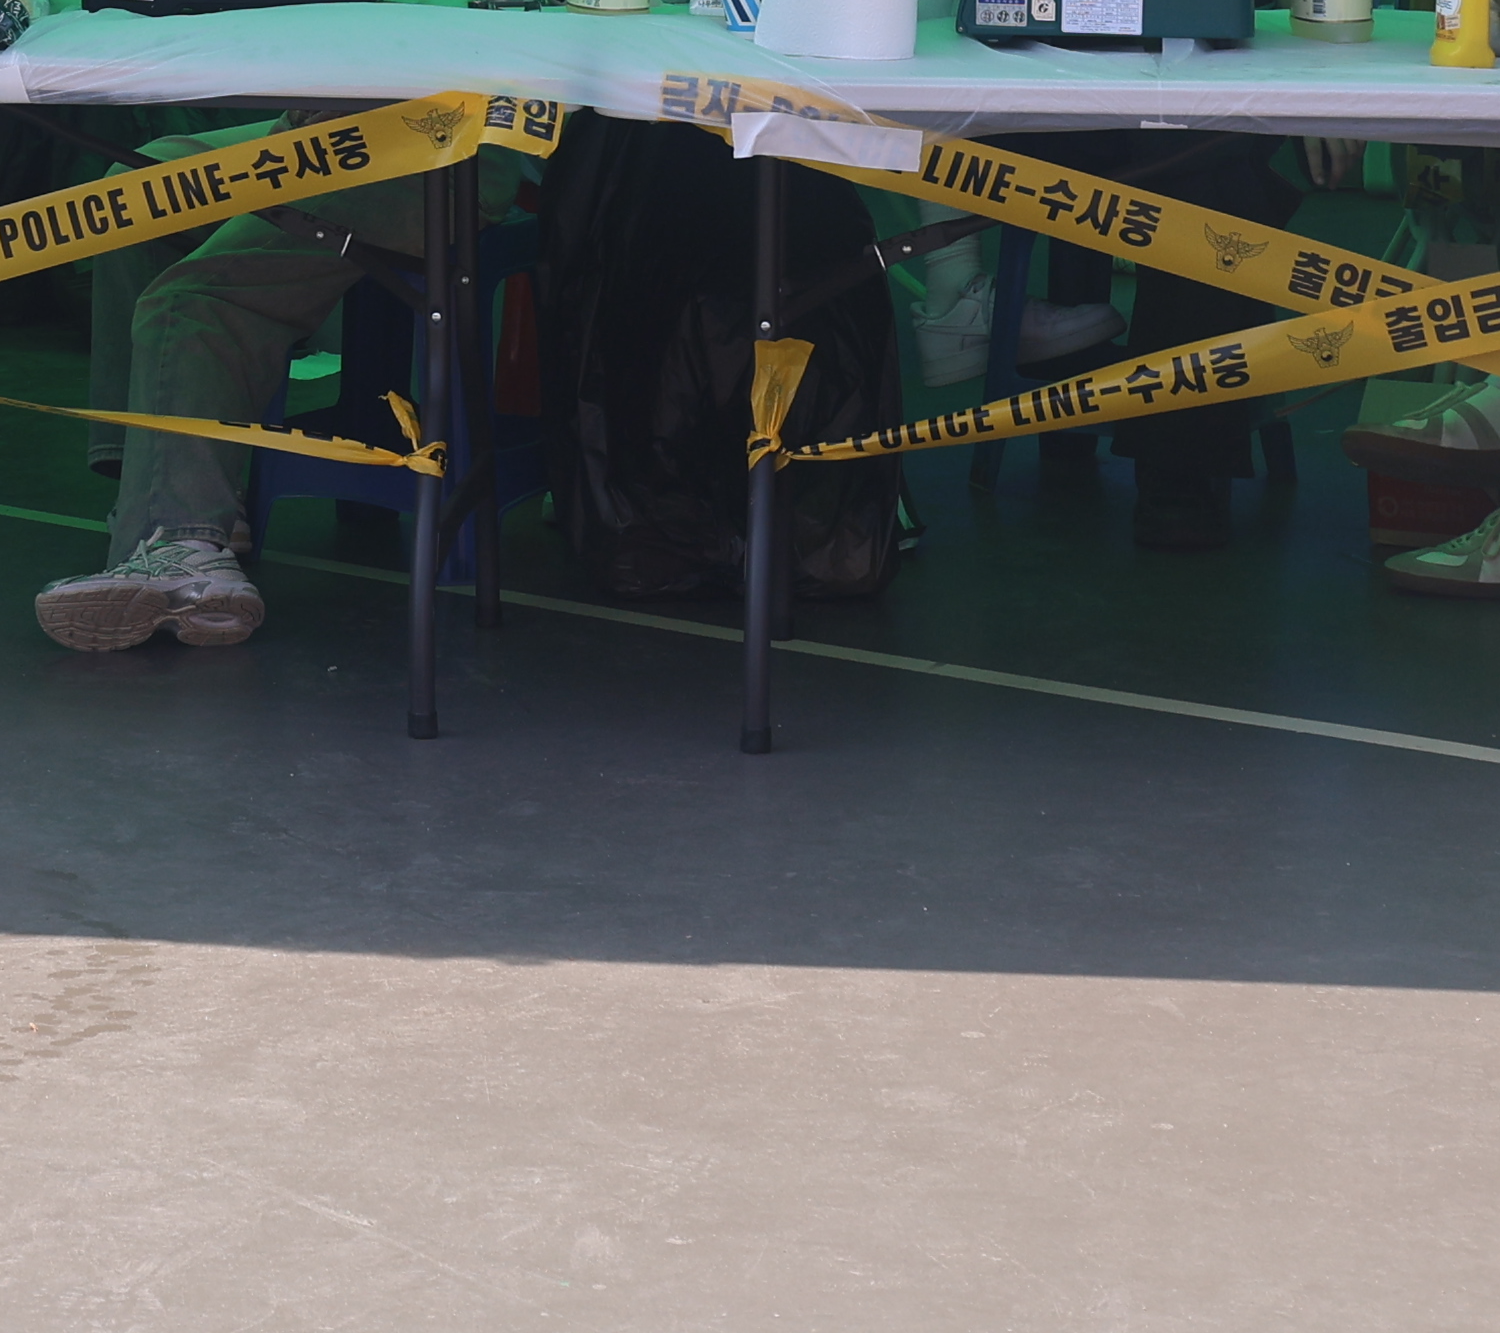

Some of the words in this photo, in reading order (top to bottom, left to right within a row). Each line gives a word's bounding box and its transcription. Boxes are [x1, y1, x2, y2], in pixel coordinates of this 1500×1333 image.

[147, 124, 373, 221] LINE-수사중
[921, 144, 1161, 247] LINE-수사중
[1008, 343, 1253, 427] LINE-수사중
